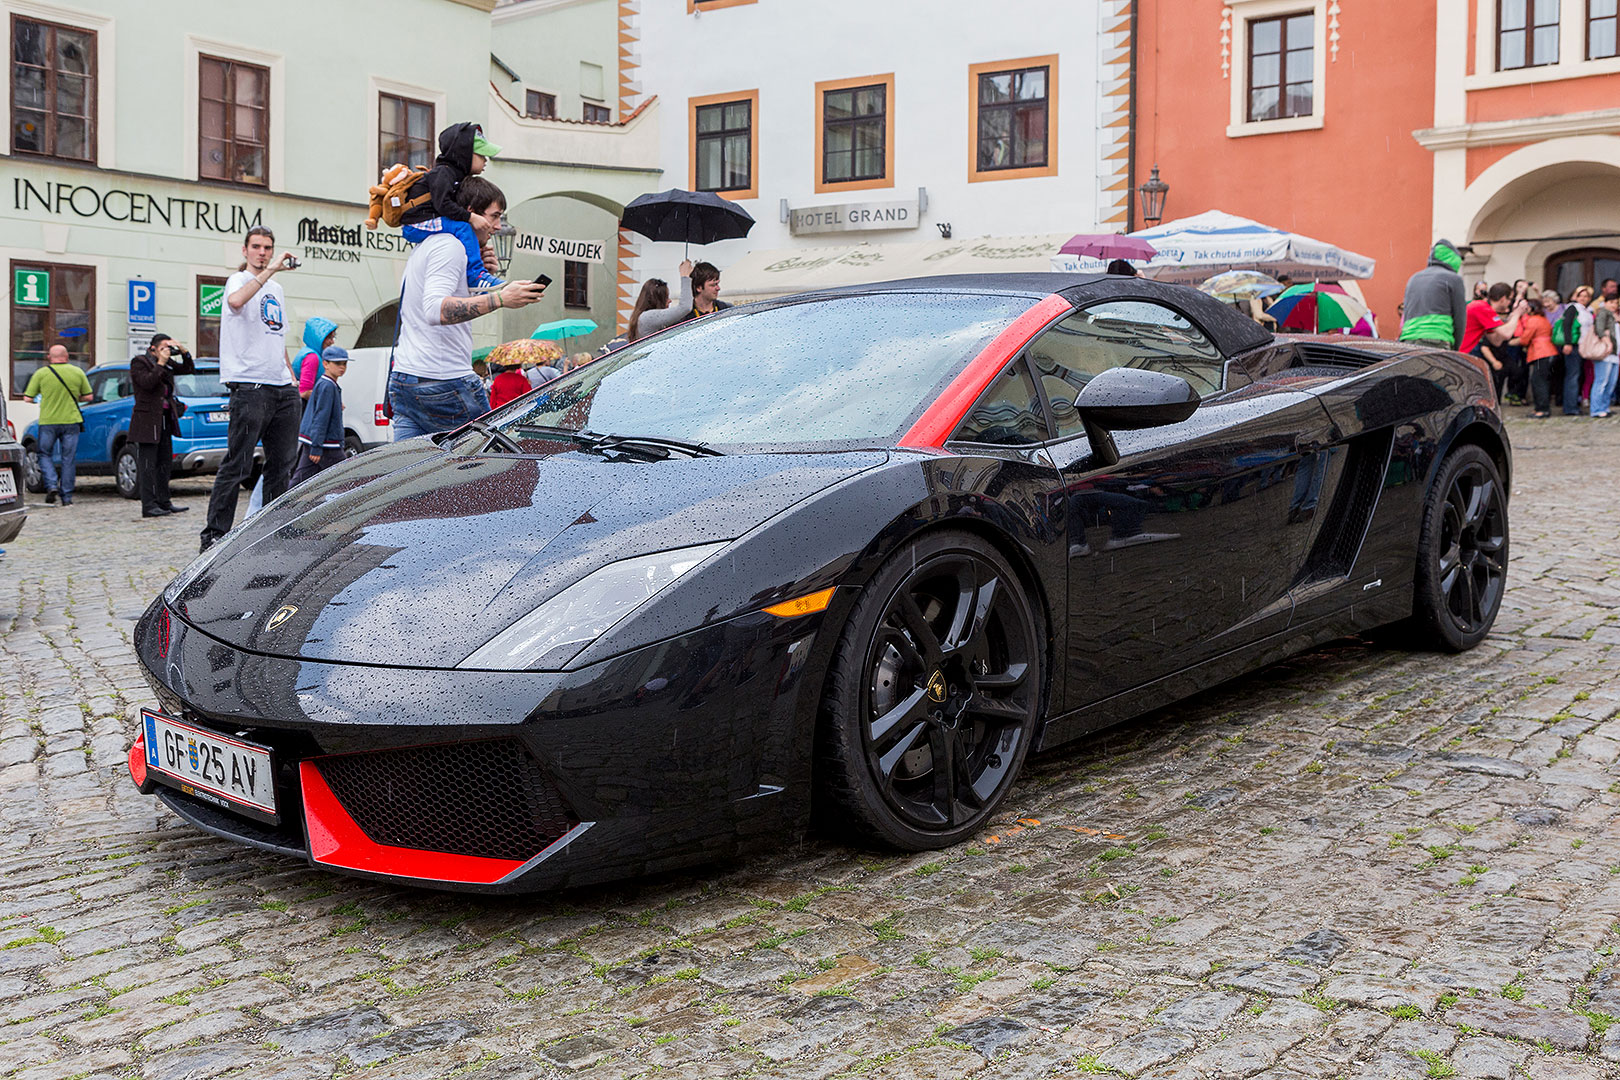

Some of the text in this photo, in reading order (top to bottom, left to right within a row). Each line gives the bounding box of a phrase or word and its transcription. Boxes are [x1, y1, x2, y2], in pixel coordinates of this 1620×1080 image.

[14, 178, 262, 233] INFOCENTRUM
[796, 207, 908, 228] HOTEL GRAND
[304, 246, 360, 263] PENZION
[516, 233, 602, 260] JAN SAUDEK
[1194, 251, 1208, 259] Tak
[1210, 249, 1242, 259] chutná
[1244, 247, 1273, 257] mléko
[1064, 262, 1078, 271] Tak
[133, 285, 151, 311] P
[151, 748, 157, 759] A
[165, 729, 256, 797] GF 25 AV
